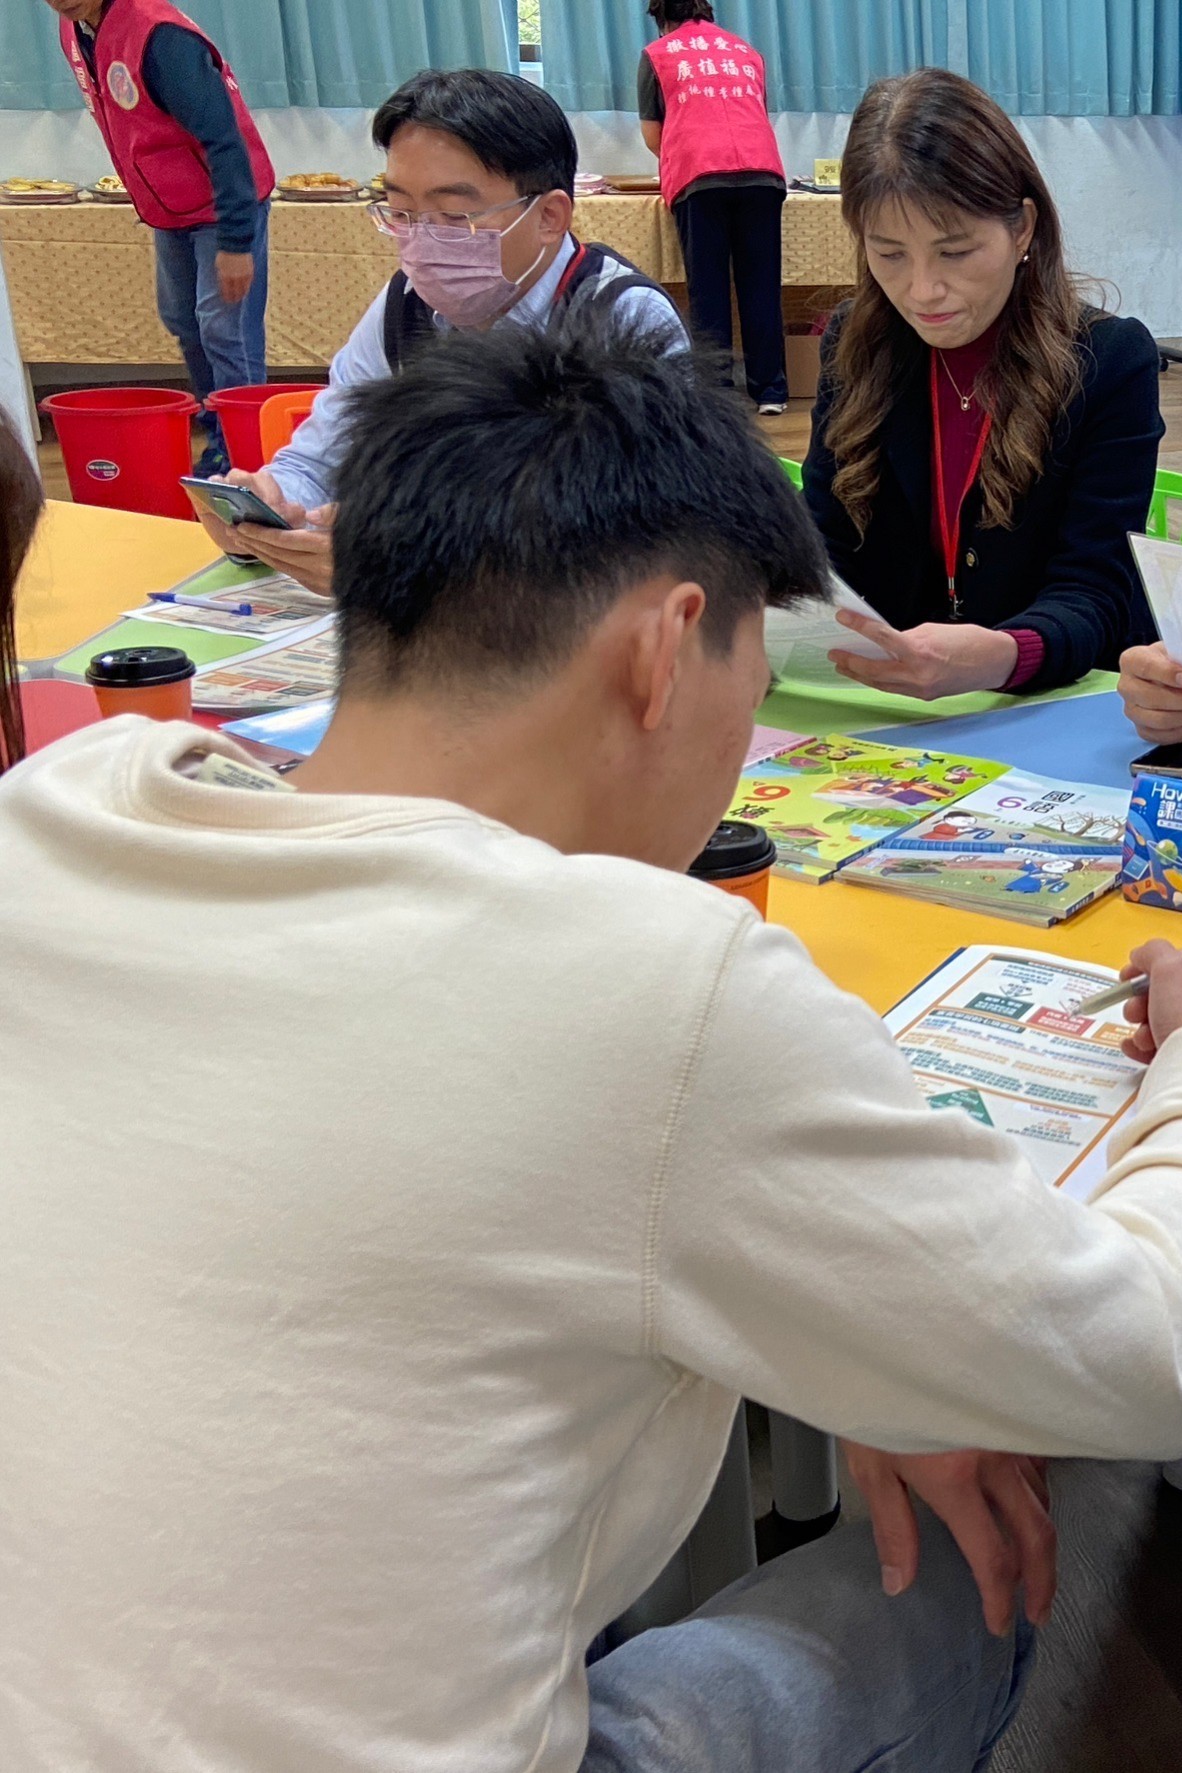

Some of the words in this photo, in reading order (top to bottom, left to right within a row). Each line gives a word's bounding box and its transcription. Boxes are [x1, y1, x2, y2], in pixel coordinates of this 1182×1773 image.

[677, 58, 756, 81] 廣植福田
[997, 796, 1027, 809] 6
[1157, 800, 1176, 820] 課
